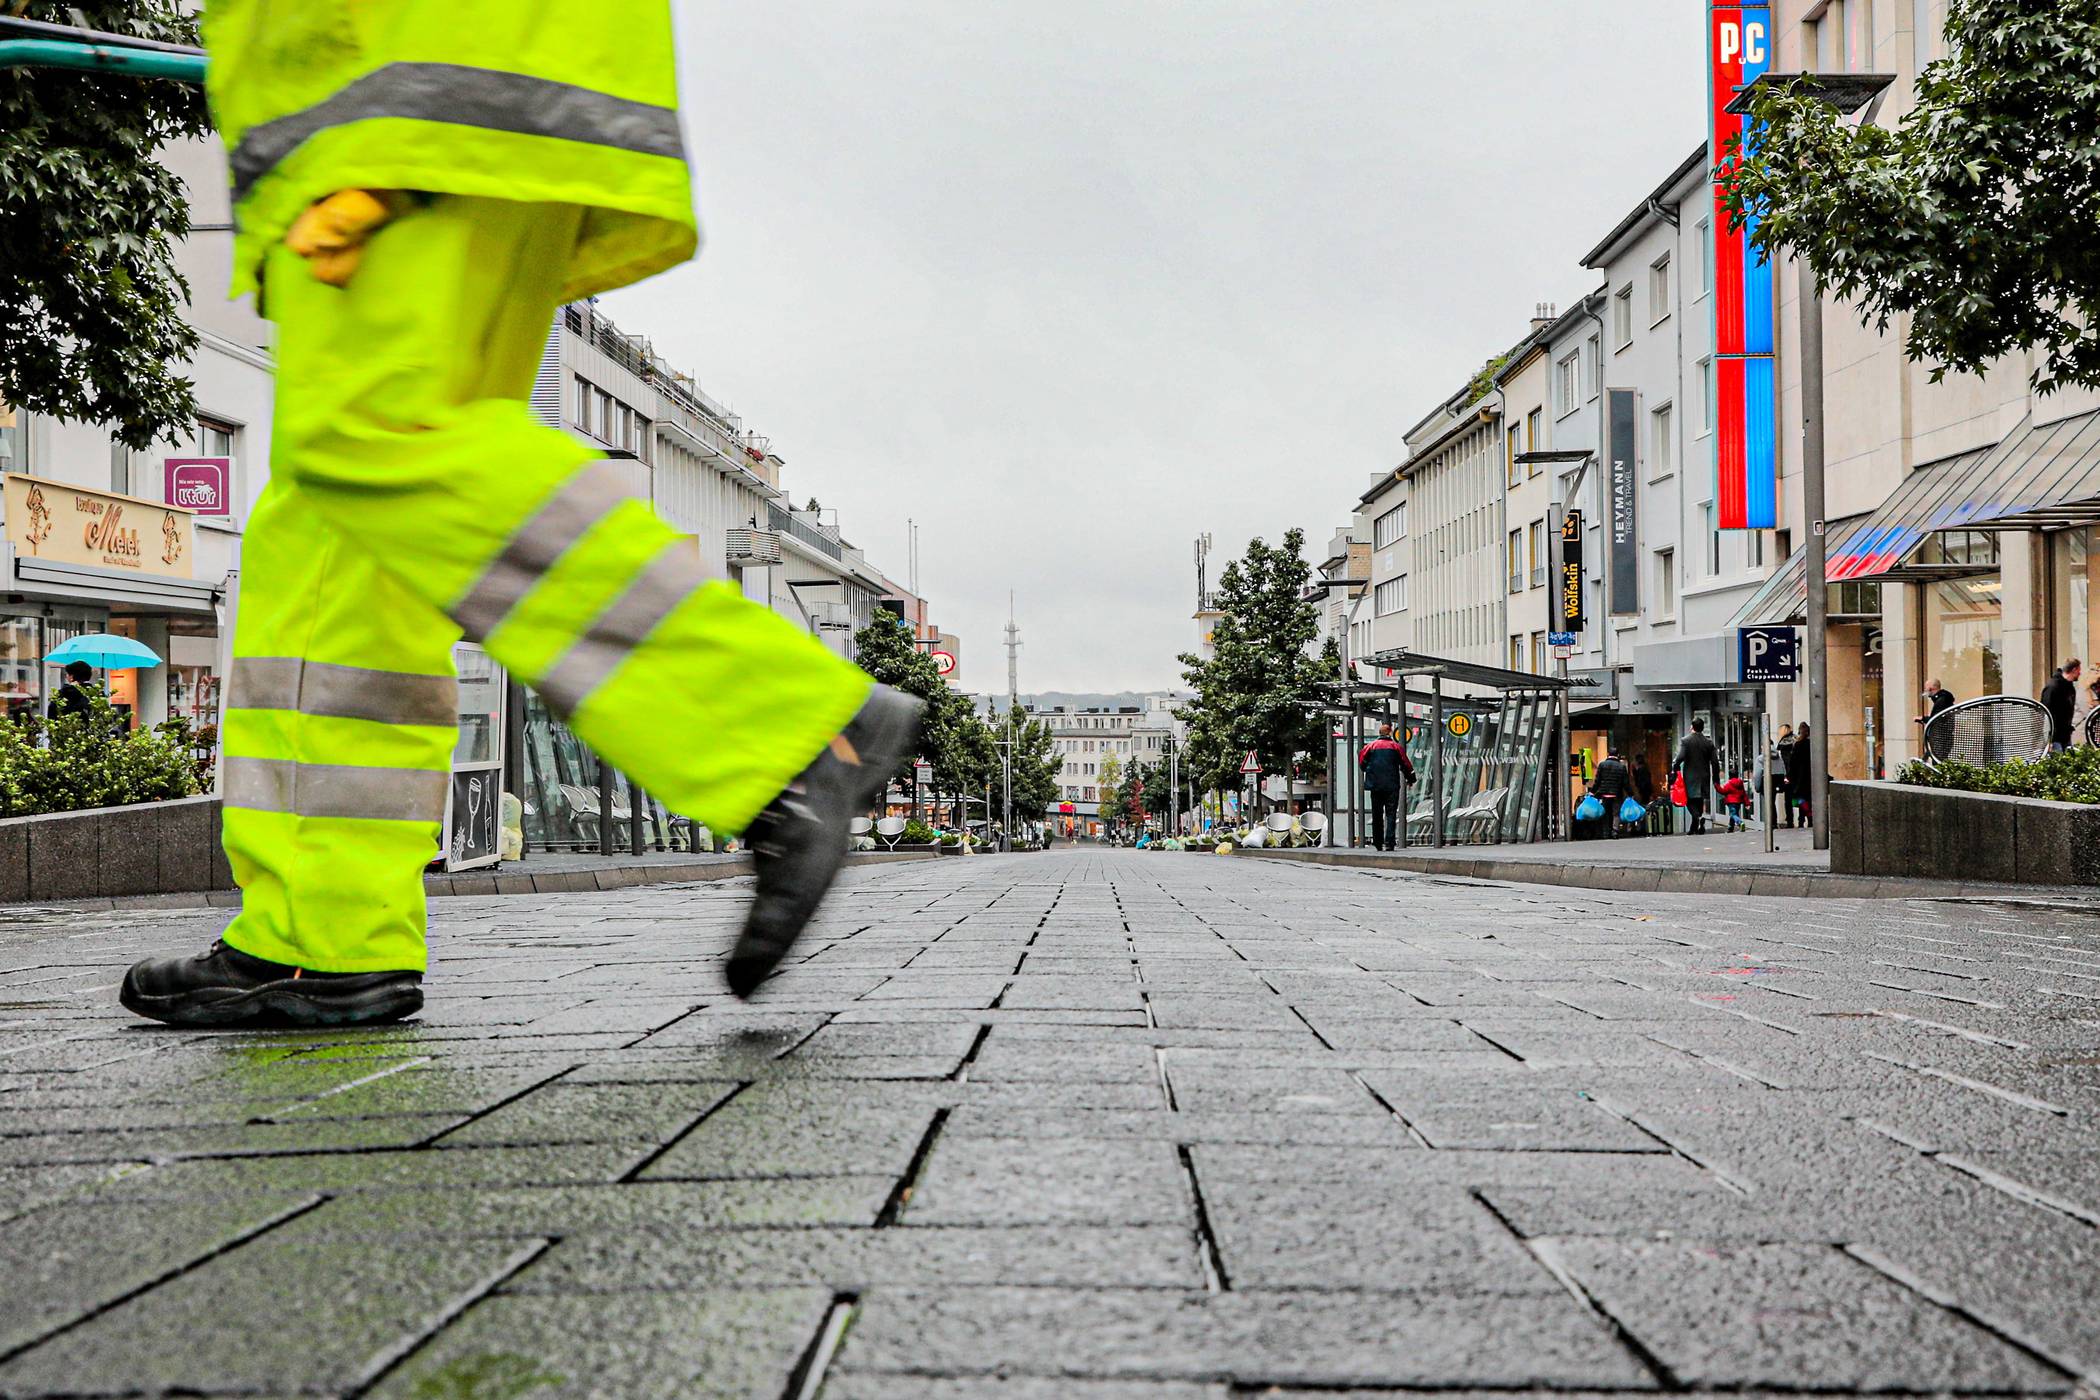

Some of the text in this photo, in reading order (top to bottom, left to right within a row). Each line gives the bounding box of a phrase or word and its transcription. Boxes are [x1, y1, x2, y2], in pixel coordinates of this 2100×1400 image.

[1625, 468, 1633, 498] TRAVEL
[1614, 460, 1625, 544] HEYMANN
[1625, 507, 1633, 534] TREND
[1567, 563, 1579, 618] Wolfskin
[1749, 637, 1768, 666] P
[1454, 718, 1465, 732] H
